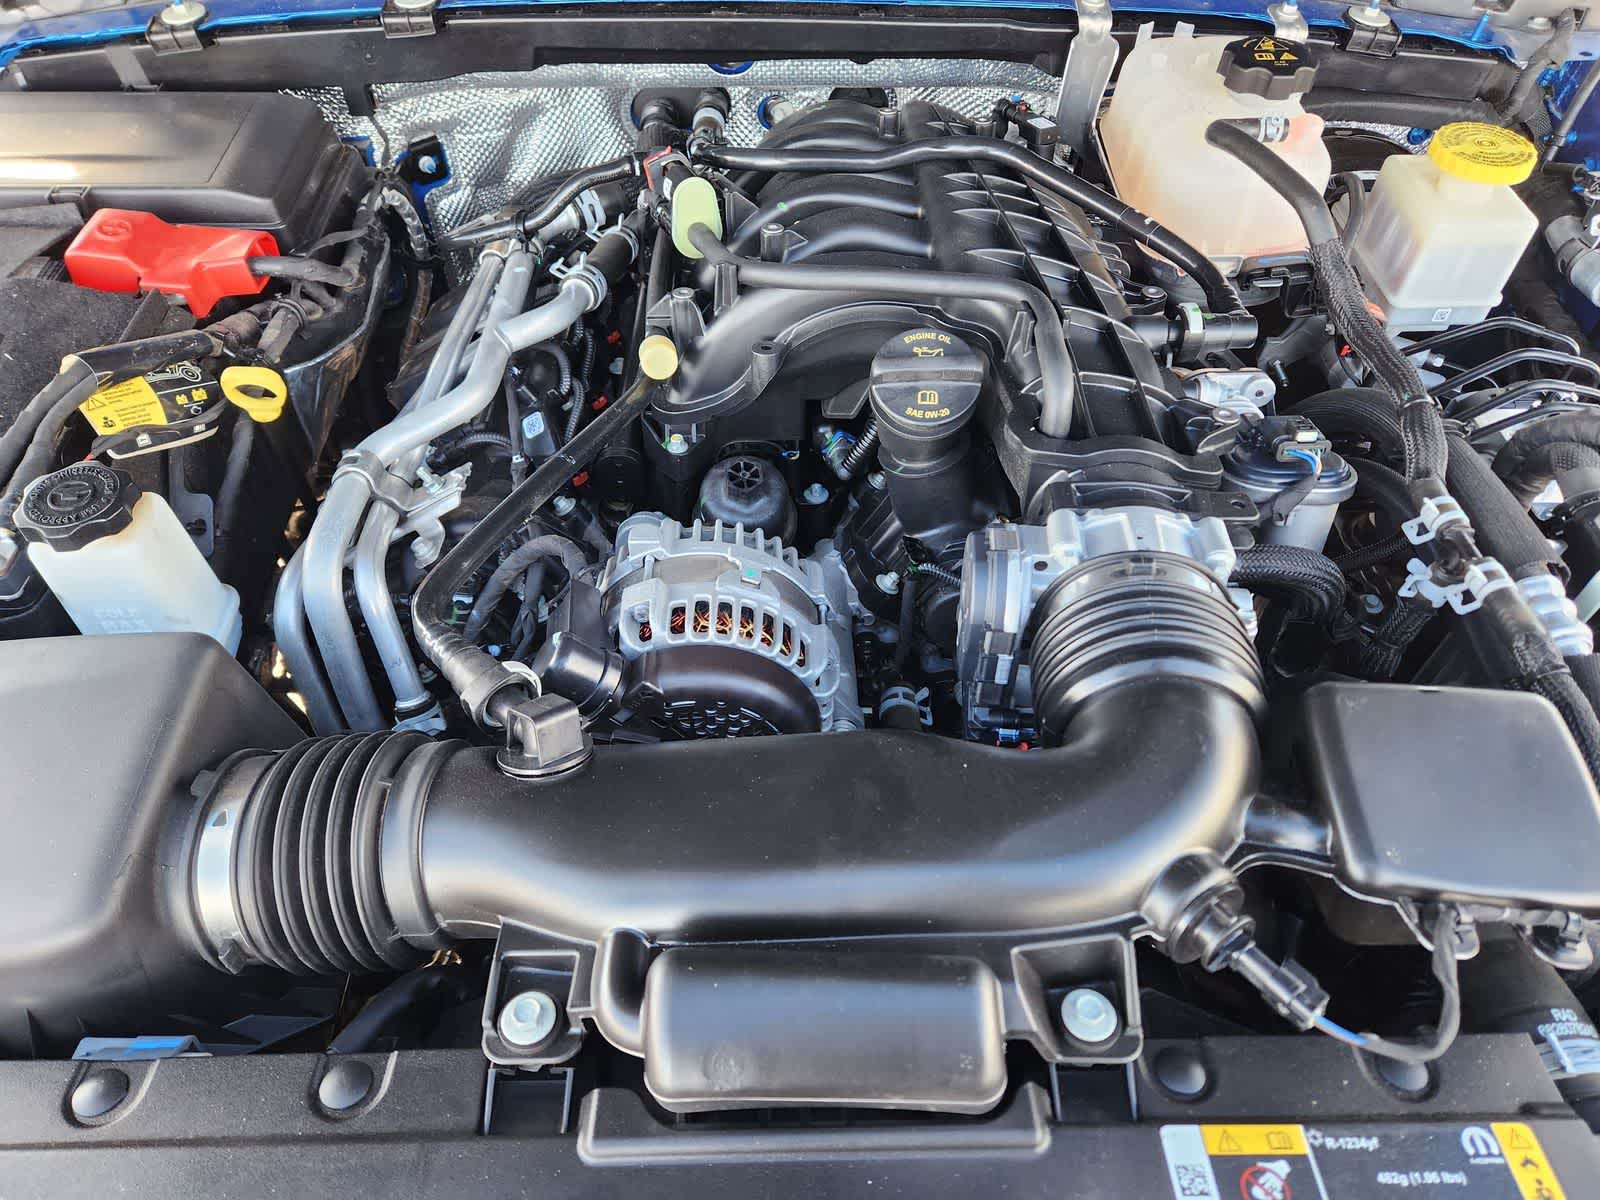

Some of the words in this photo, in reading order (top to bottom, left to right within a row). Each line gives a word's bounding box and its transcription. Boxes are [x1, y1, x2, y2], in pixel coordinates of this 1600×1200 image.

[903, 332, 937, 344] ENGINE
[938, 334, 952, 345] OIL
[905, 407, 924, 418] SAE
[924, 407, 951, 419] 0W-20
